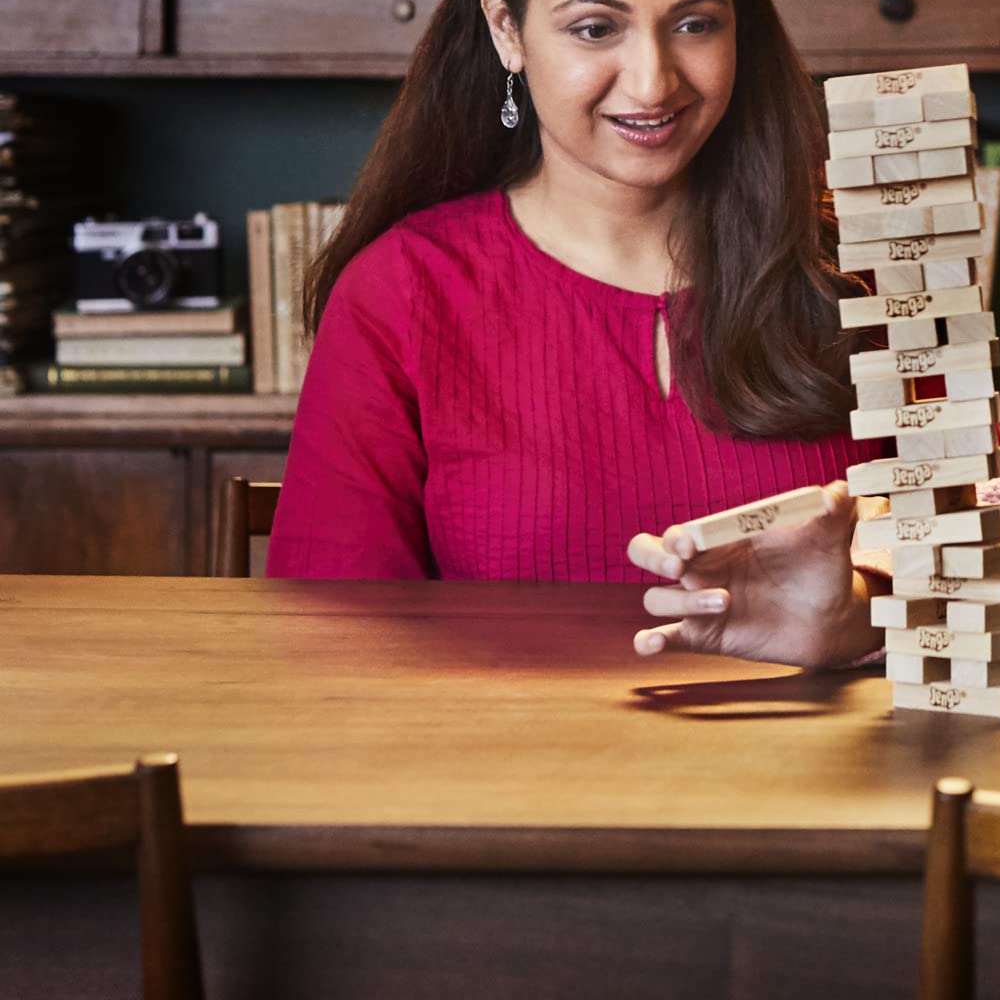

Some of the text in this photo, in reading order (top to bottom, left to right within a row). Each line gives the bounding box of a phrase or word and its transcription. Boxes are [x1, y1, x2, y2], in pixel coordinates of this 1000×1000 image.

[875, 127, 914, 149] Jenga
[881, 183, 920, 205] Jenga
[889, 239, 928, 260] Jenga
[886, 295, 926, 317] Jenga
[897, 351, 936, 373] Jenga
[896, 406, 935, 428] Jenga
[893, 464, 933, 487] Jenga
[919, 630, 951, 652] Jenga
[929, 684, 961, 709] Jenga
